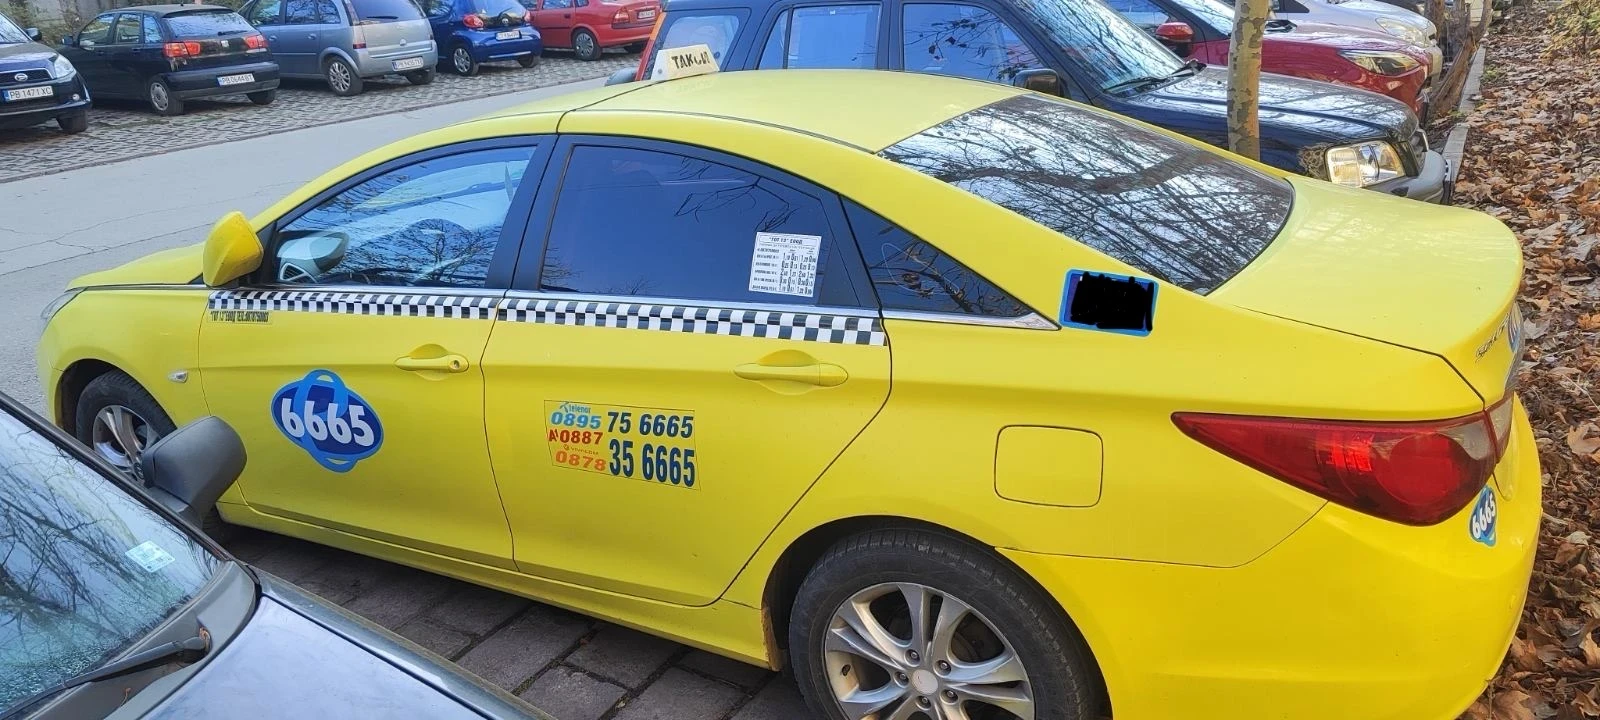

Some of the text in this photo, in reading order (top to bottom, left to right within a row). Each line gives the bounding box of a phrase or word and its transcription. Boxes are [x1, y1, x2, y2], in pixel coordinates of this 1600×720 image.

[22, 88, 39, 97] 1471
[41, 86, 51, 95] XC
[281, 397, 375, 447] 6665
[551, 411, 694, 438] 0895 75 6665
[560, 430, 604, 445] 0887
[555, 450, 607, 471] 0878
[609, 438, 695, 487] 35 6665
[1472, 492, 1496, 539] 6665
